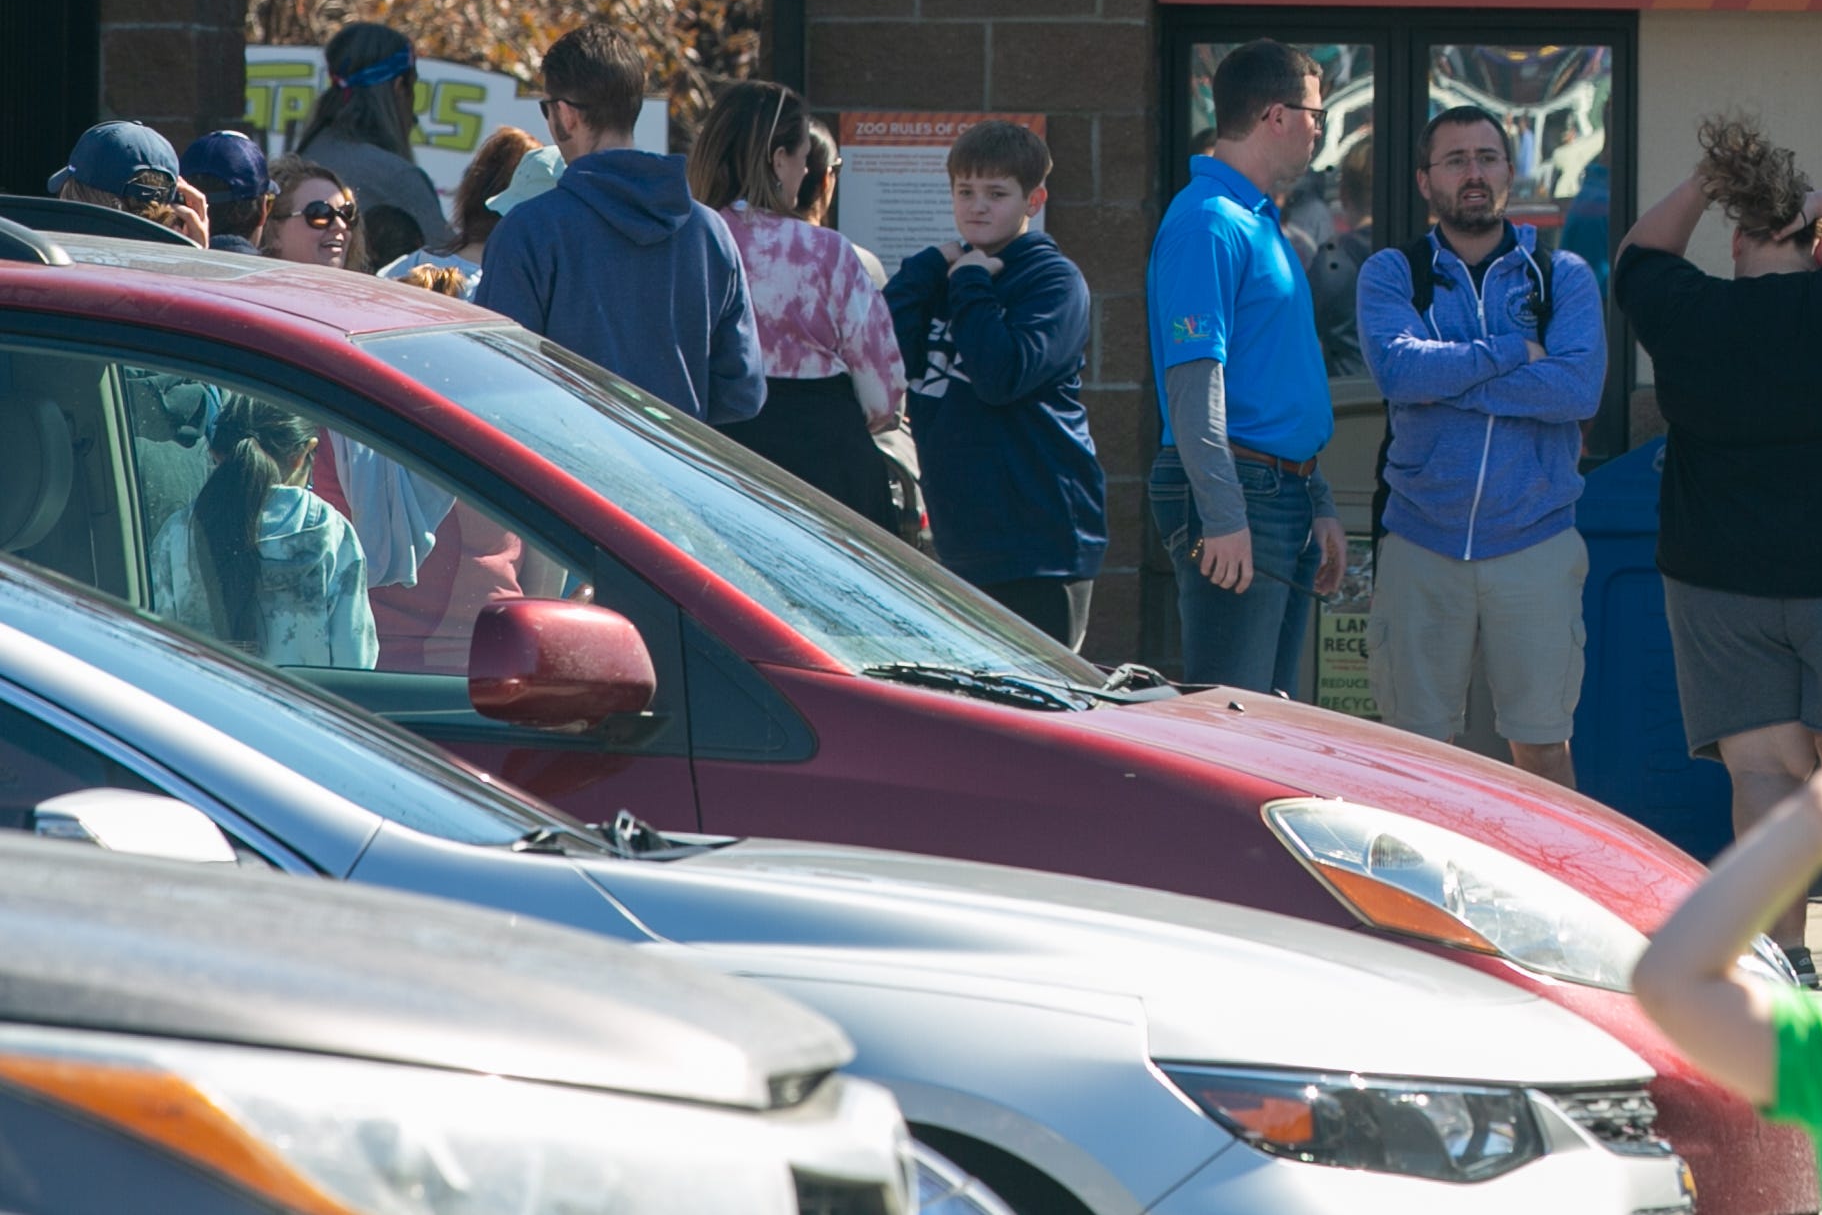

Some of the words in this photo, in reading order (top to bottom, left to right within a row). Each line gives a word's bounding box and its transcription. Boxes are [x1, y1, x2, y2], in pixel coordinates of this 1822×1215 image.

[855, 122, 887, 135] ZOO
[889, 123, 932, 136] RULES
[935, 124, 954, 136] OF
